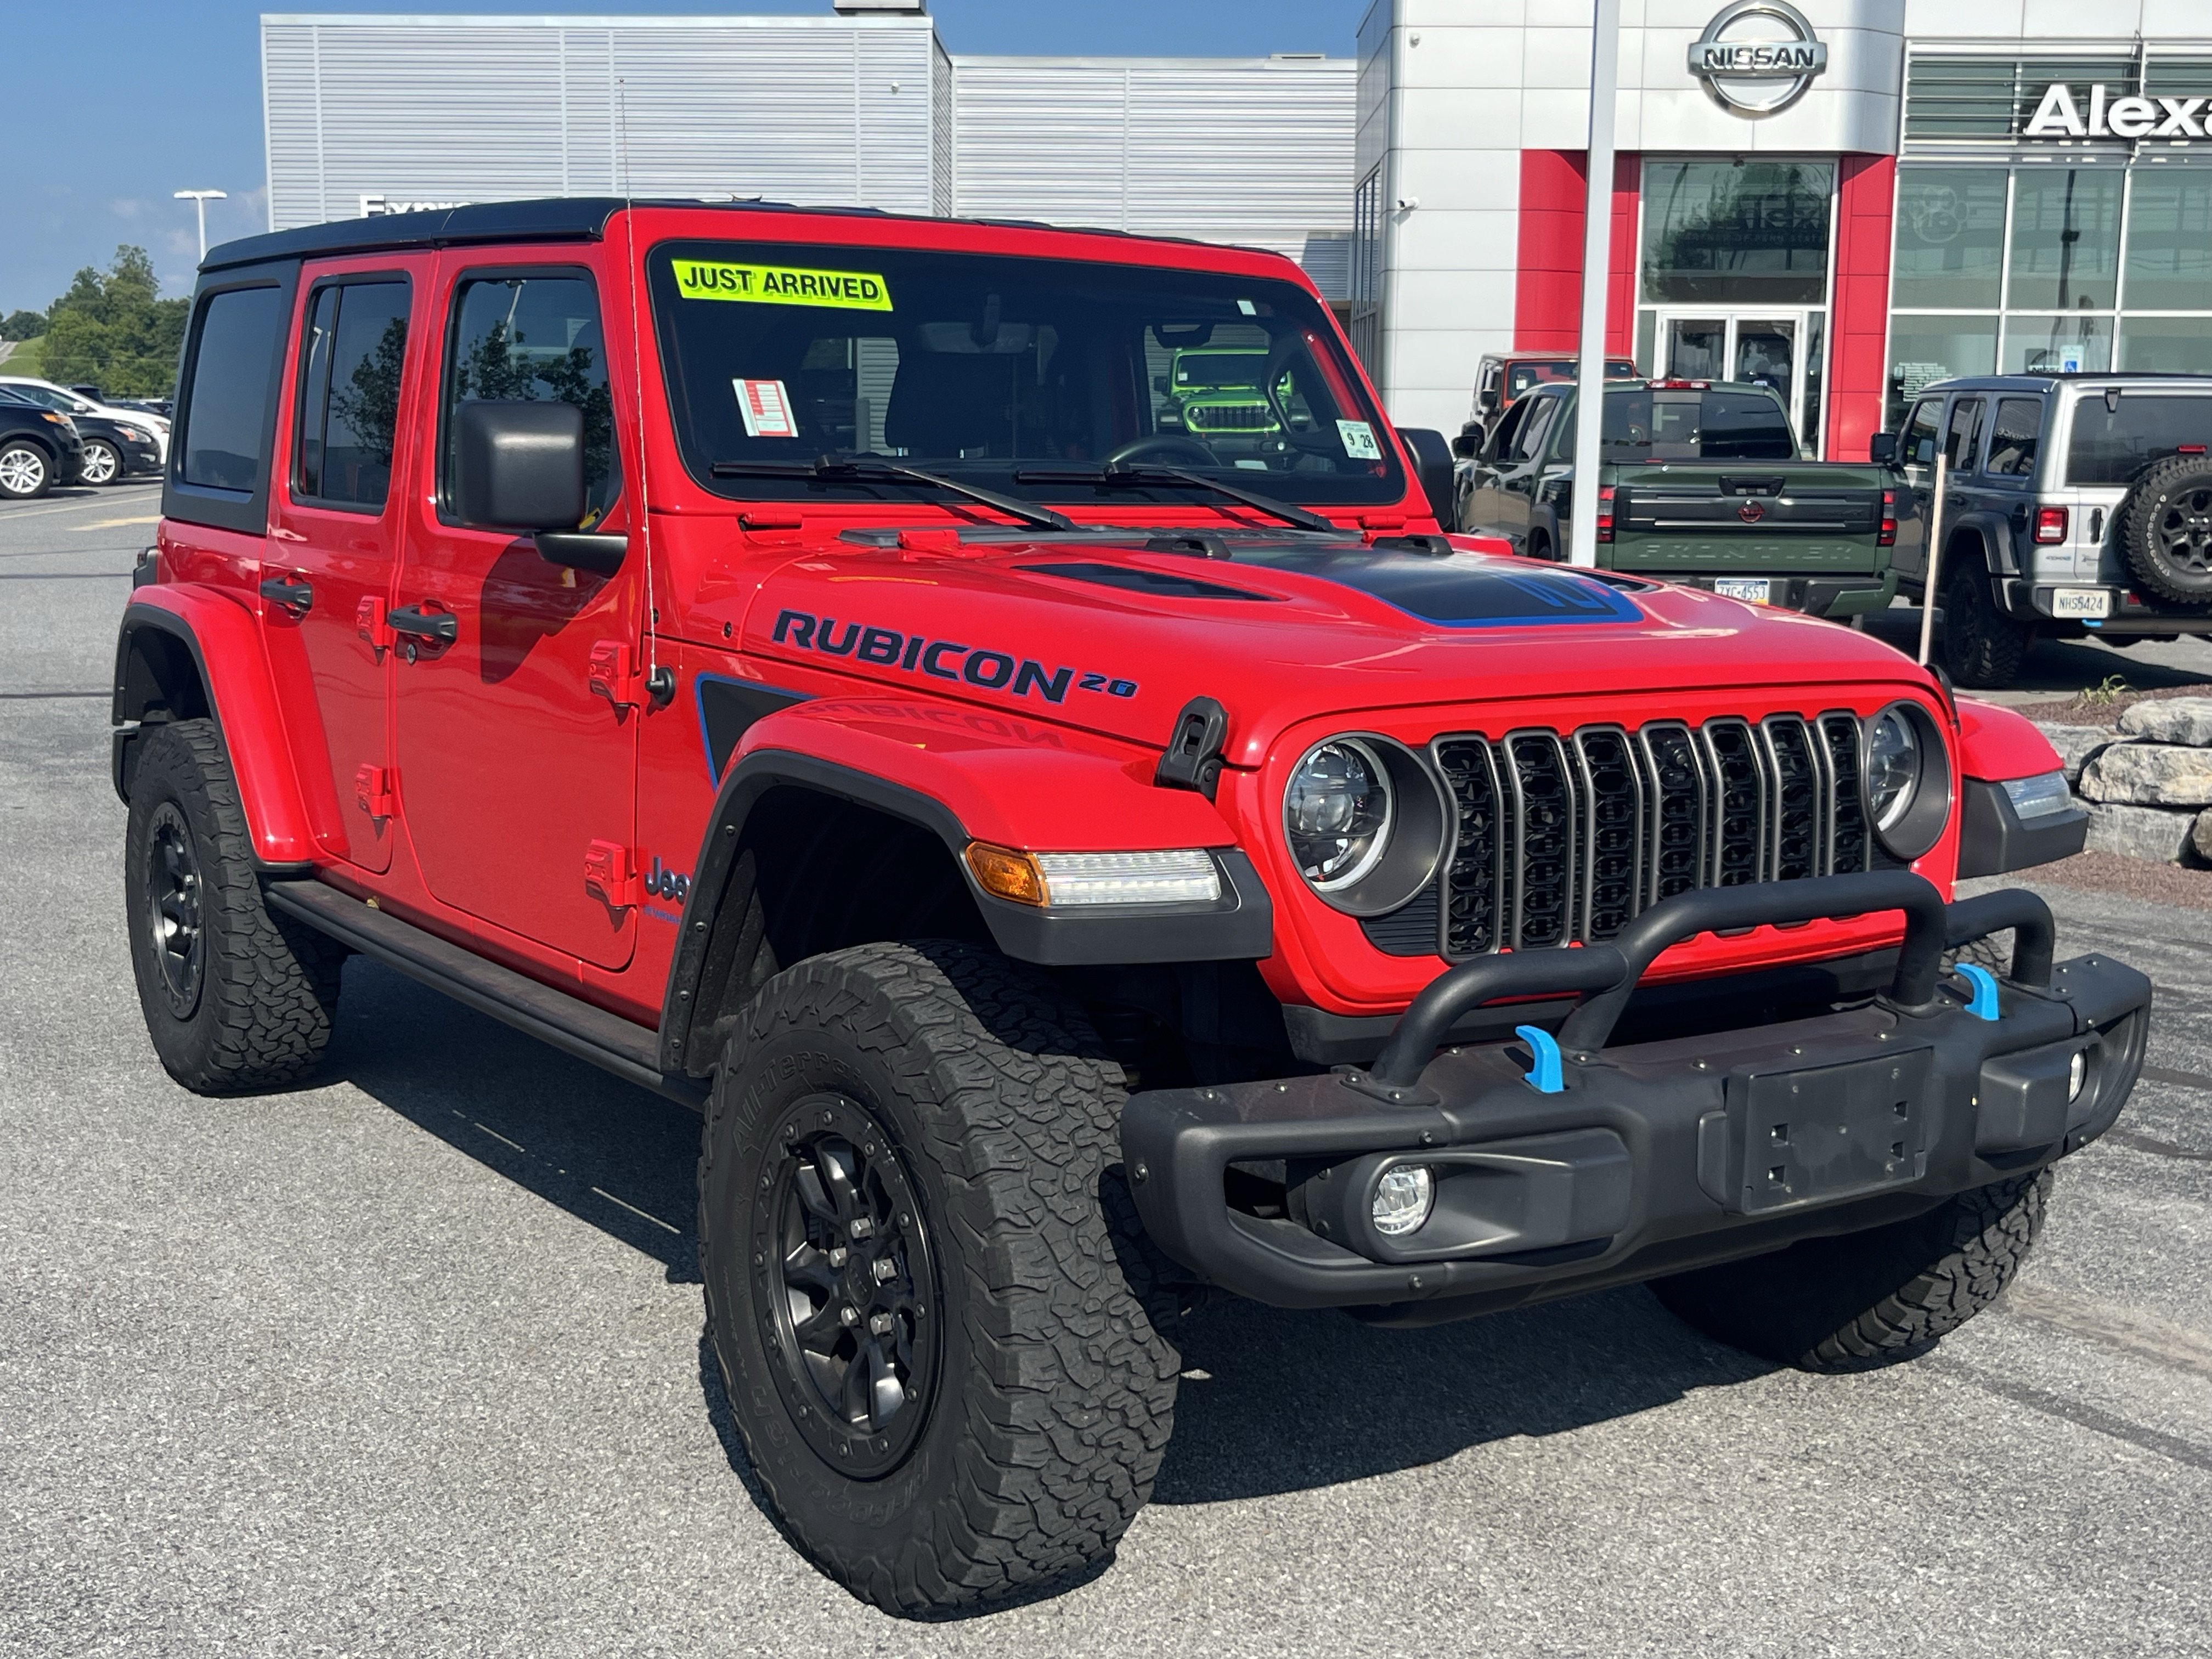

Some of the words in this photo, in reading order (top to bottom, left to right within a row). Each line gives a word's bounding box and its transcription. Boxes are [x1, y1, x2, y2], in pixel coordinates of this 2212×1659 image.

[1702, 47, 1815, 70] NISSAN
[684, 267, 753, 292] JUST
[763, 272, 879, 300] ARRIVED
[1347, 432, 1355, 446] 9
[1359, 434, 1374, 449] 28
[1639, 544, 1852, 560] FRONTIER
[771, 608, 1075, 704] RUBICON
[1078, 672, 1139, 698] 20
[645, 856, 691, 905] Jee
